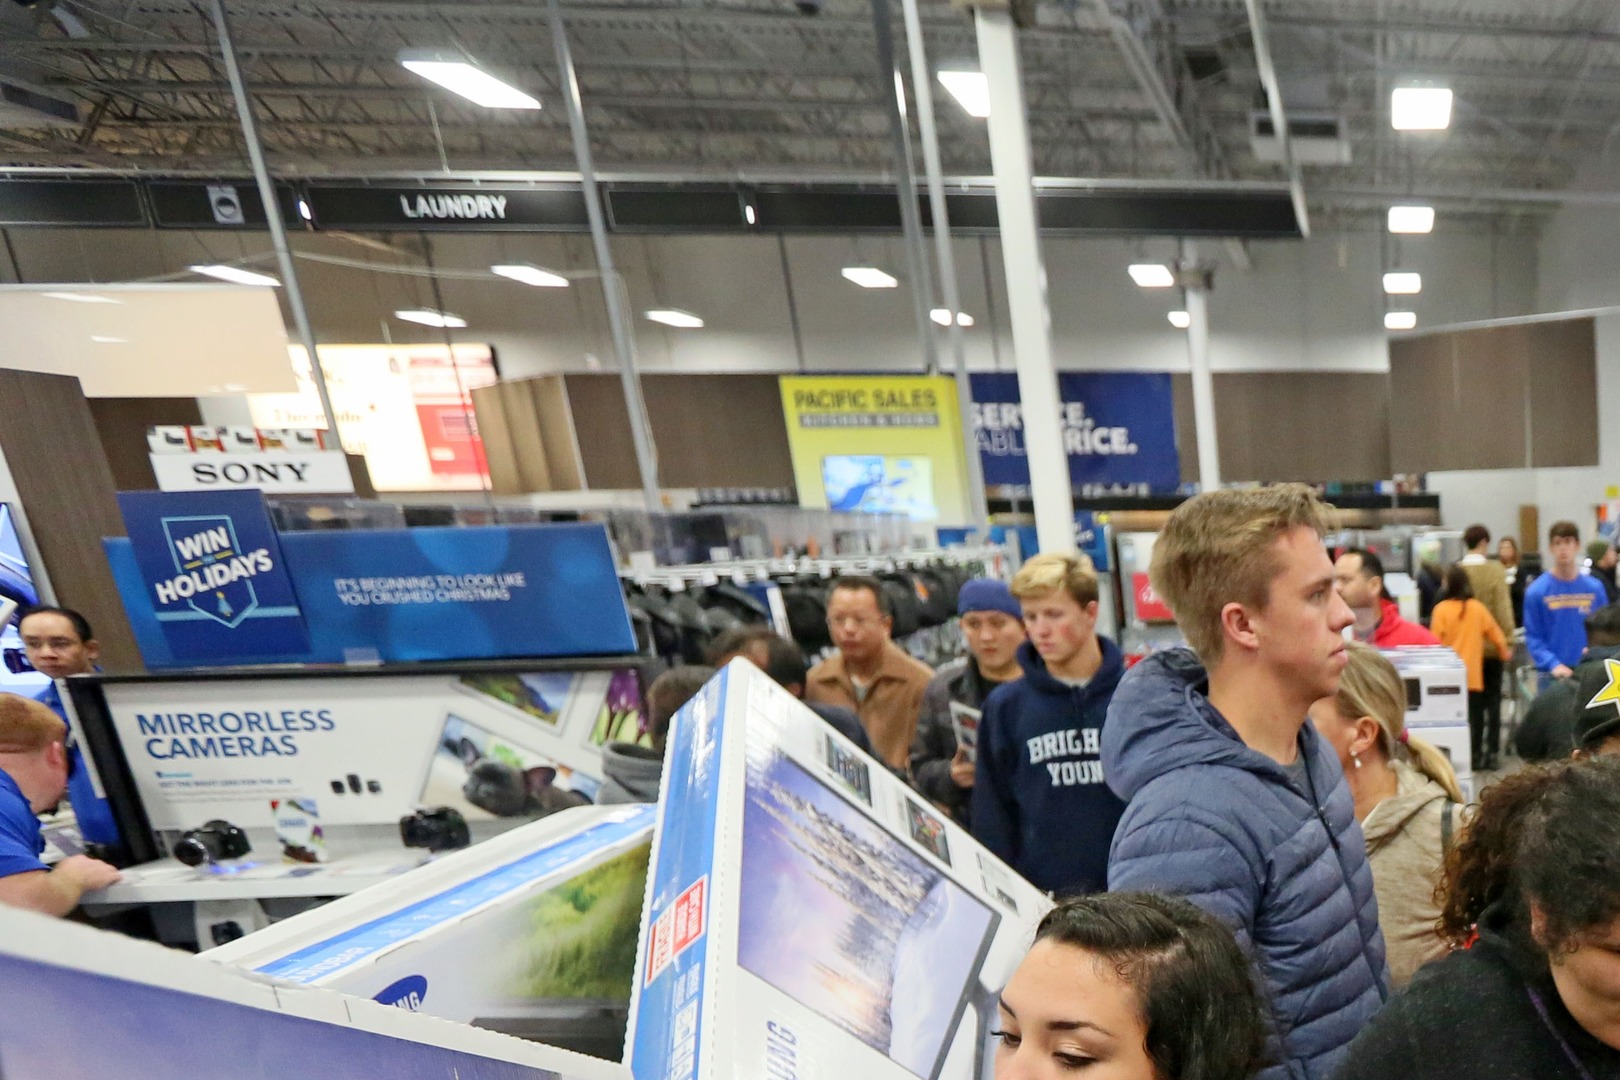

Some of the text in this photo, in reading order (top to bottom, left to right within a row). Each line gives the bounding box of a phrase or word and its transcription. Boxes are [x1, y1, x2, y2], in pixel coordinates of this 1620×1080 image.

[400, 194, 507, 219] LAUNDRY
[794, 388, 937, 408] PACIFIC SALES
[970, 401, 1095, 430] SERE.
[975, 427, 1139, 457] ABL RICE.
[192, 463, 311, 483] SONY
[175, 526, 231, 561] WIN
[155, 548, 273, 604] HOLIDAYS
[334, 572, 527, 593] IT'S BEGINNING TO LOOK LIKE
[338, 587, 511, 606] YOU CRUSHED CHRISTMAS
[136, 710, 335, 735] MIRRORLESS
[146, 735, 298, 760] CAMERAS
[1026, 728, 1100, 764] BRIGH
[1046, 760, 1105, 787] YOUN
